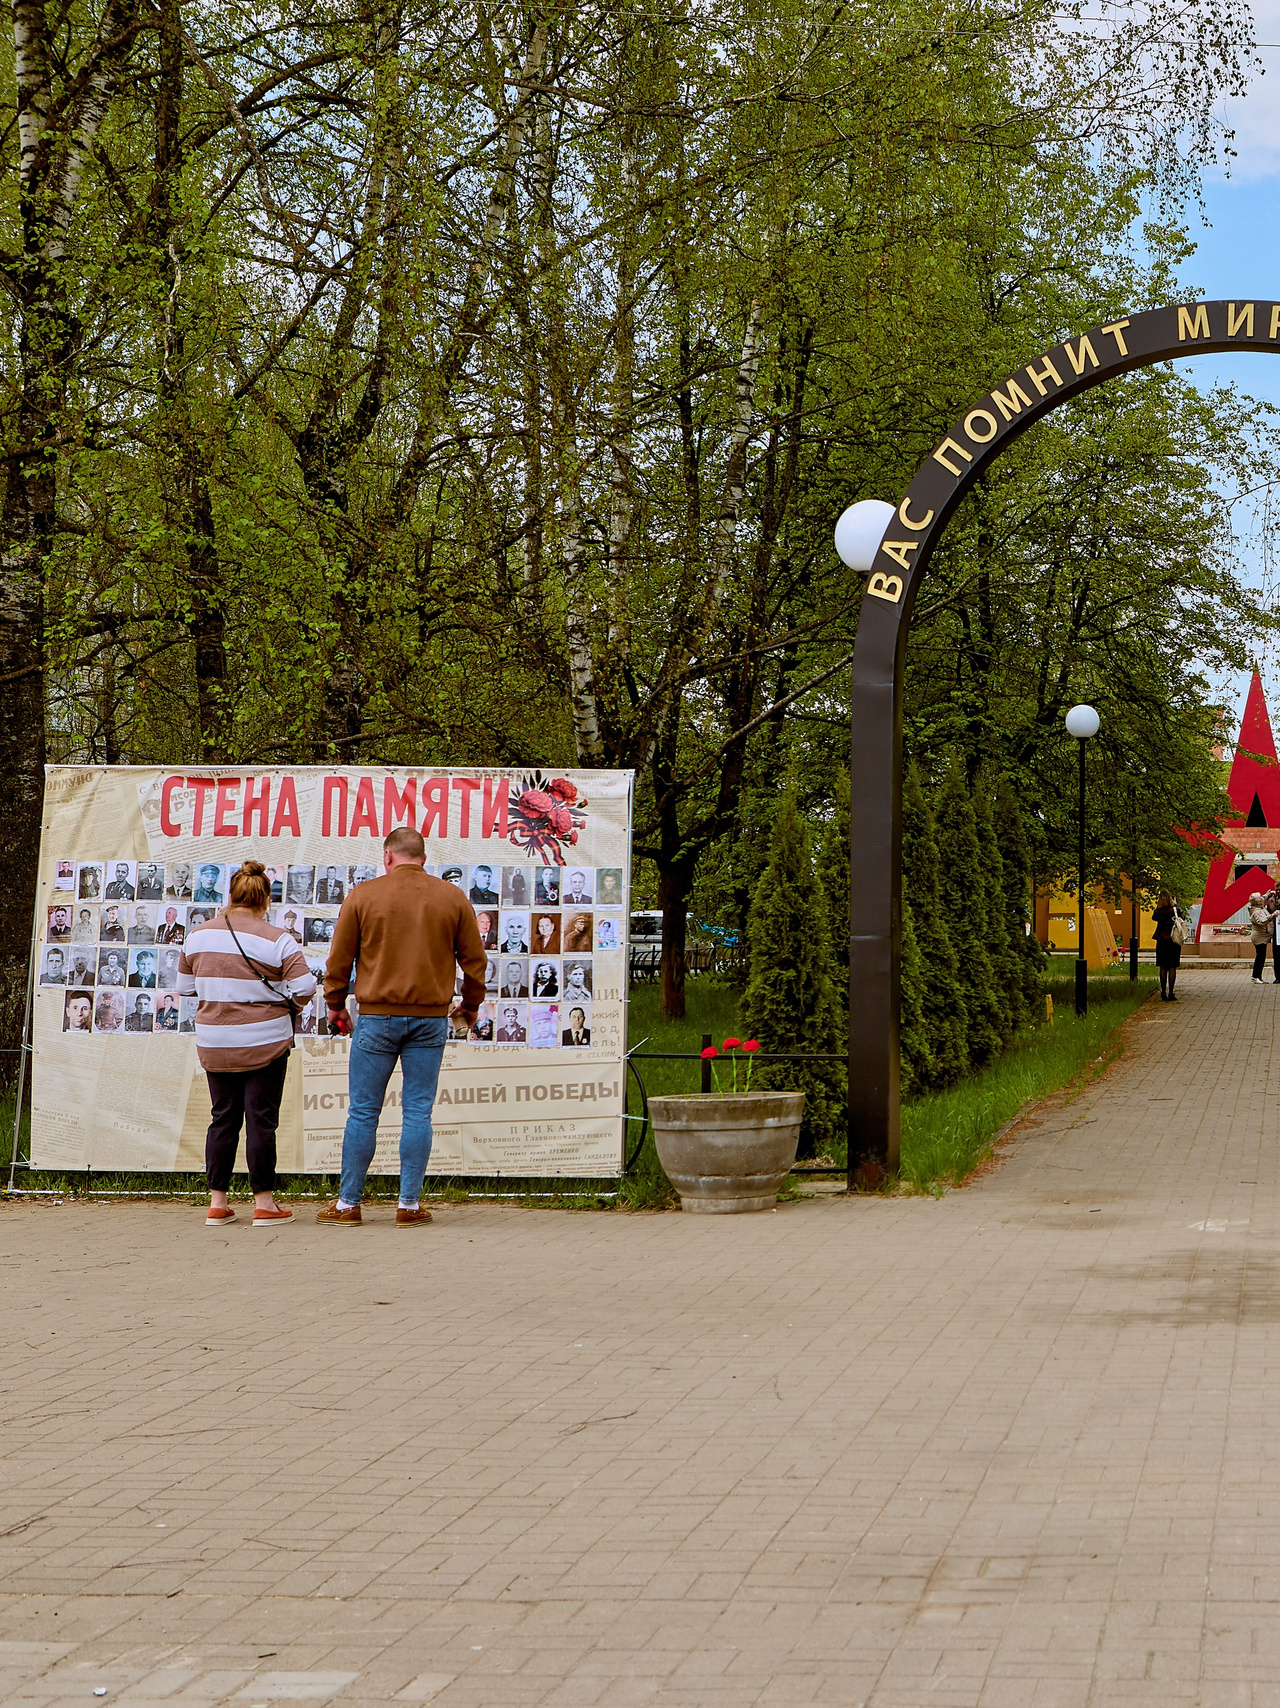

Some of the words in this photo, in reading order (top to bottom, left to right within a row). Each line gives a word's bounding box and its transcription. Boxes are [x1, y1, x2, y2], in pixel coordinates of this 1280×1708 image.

[866, 496, 936, 603] ВАС
[931, 317, 1133, 477] ПОМНИТ
[161, 775, 301, 837] СТЕНА
[321, 776, 509, 839] ПАМЯТИ
[304, 1090, 403, 1110] ИСТИ
[437, 1084, 506, 1105] АШЕЙ
[515, 1082, 619, 1102] ПОБЕДЫ
[473, 1136, 521, 1144] Верховного
[525, 1132, 613, 1143] Главнокомандующего
[510, 1124, 577, 1134] ПРИКАЗ
